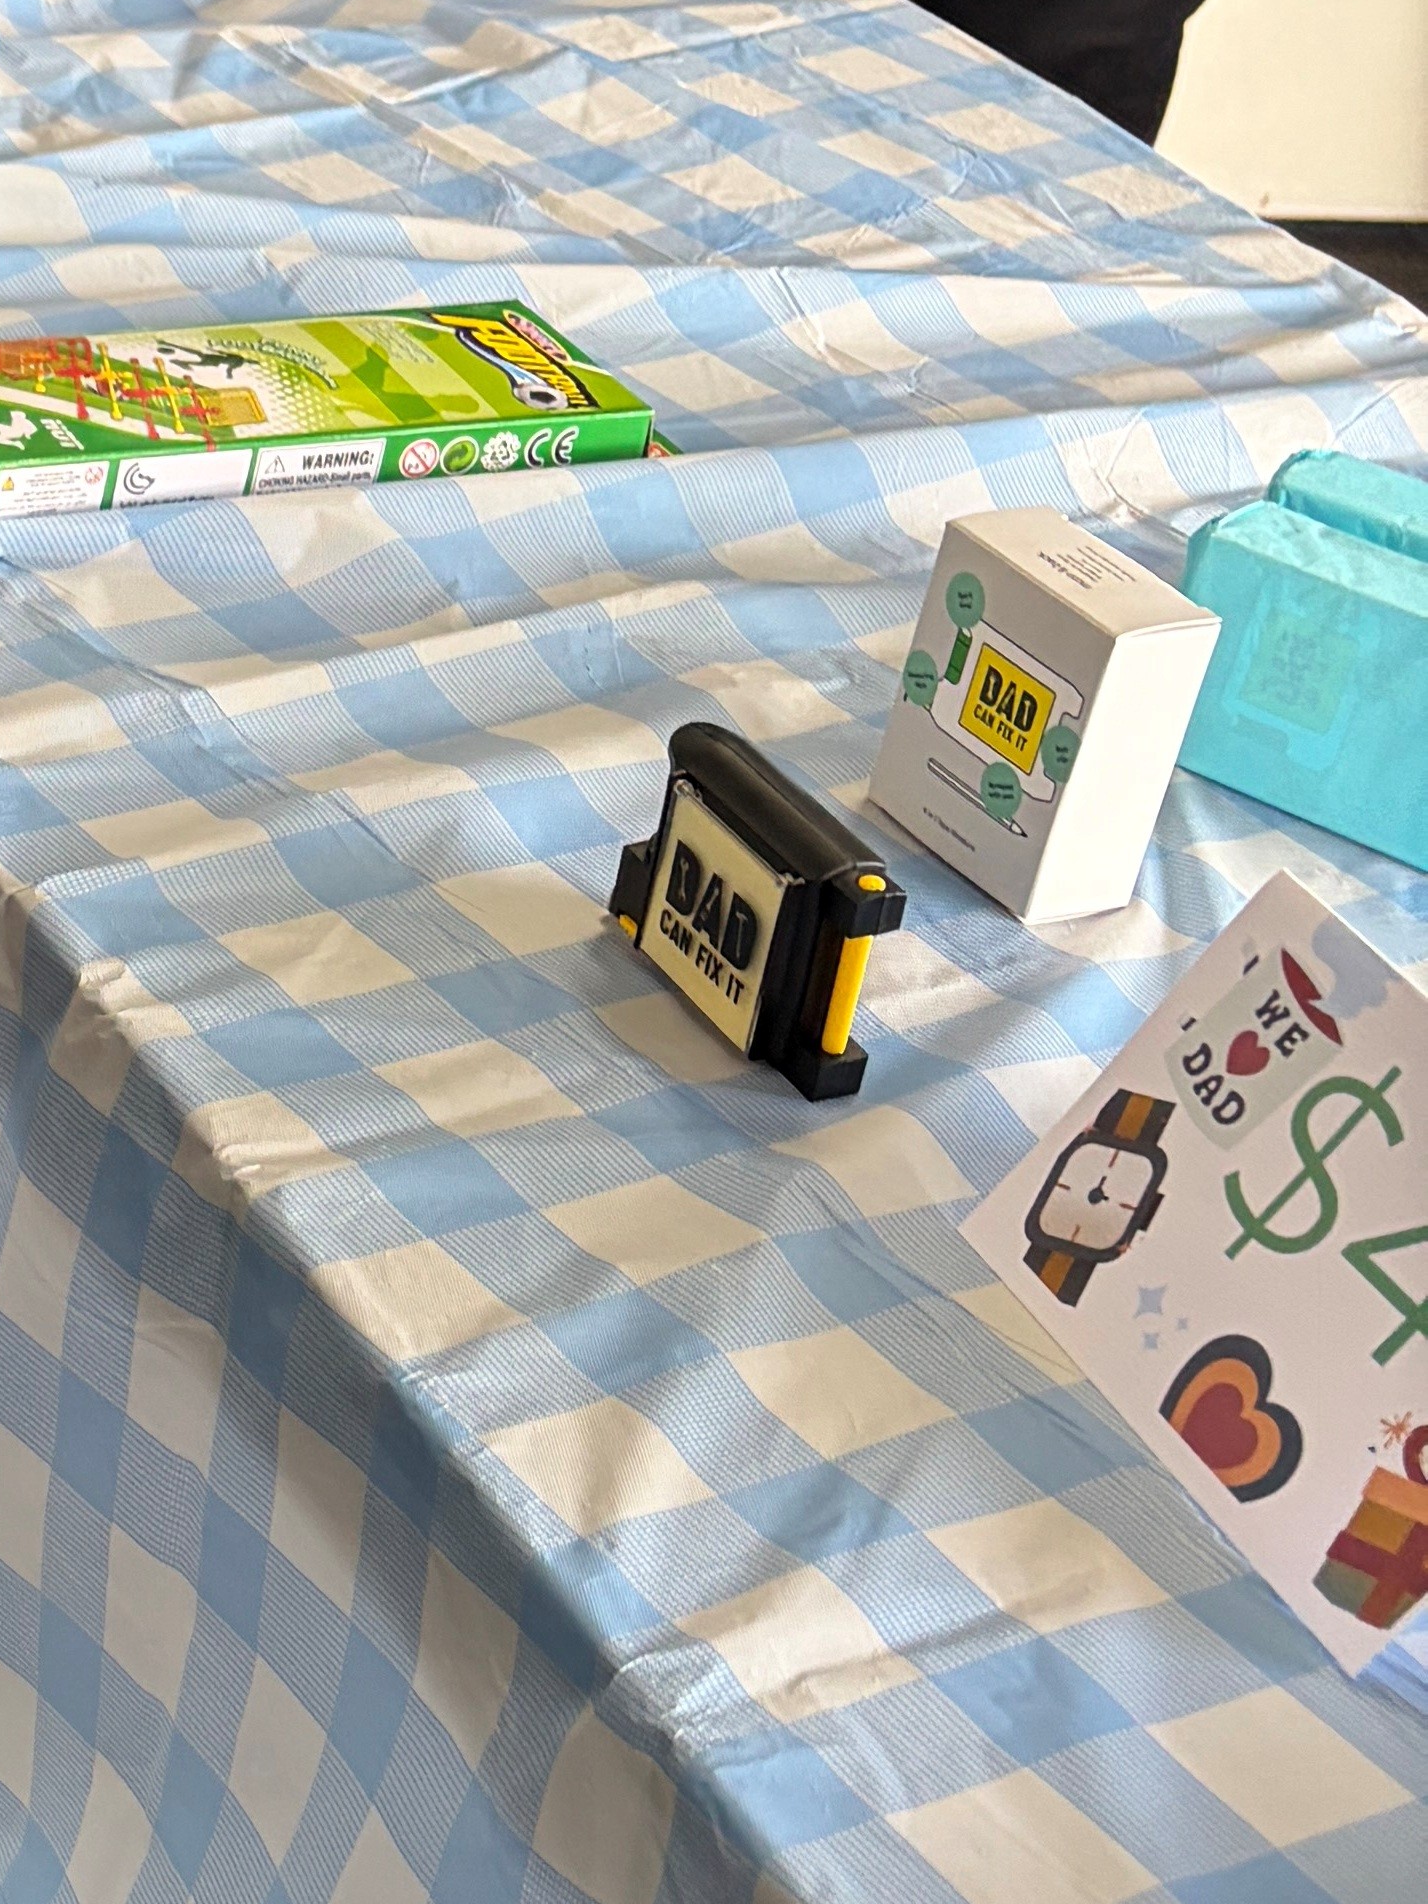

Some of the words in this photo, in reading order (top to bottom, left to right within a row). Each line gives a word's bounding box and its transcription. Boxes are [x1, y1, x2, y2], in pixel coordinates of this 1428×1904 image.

[973, 703, 996, 729] CAN
[996, 720, 1015, 744] FIX
[1015, 734, 1029, 752] IT
[978, 664, 1038, 733] DAD
[665, 838, 758, 971] DAD
[659, 908, 693, 957] CAN
[694, 943, 724, 988] FIX
[725, 972, 746, 1006] IT
[1254, 988, 1311, 1059] WE
[1181, 1042, 1247, 1126] DAD
[1224, 1065, 1428, 1368] $4
